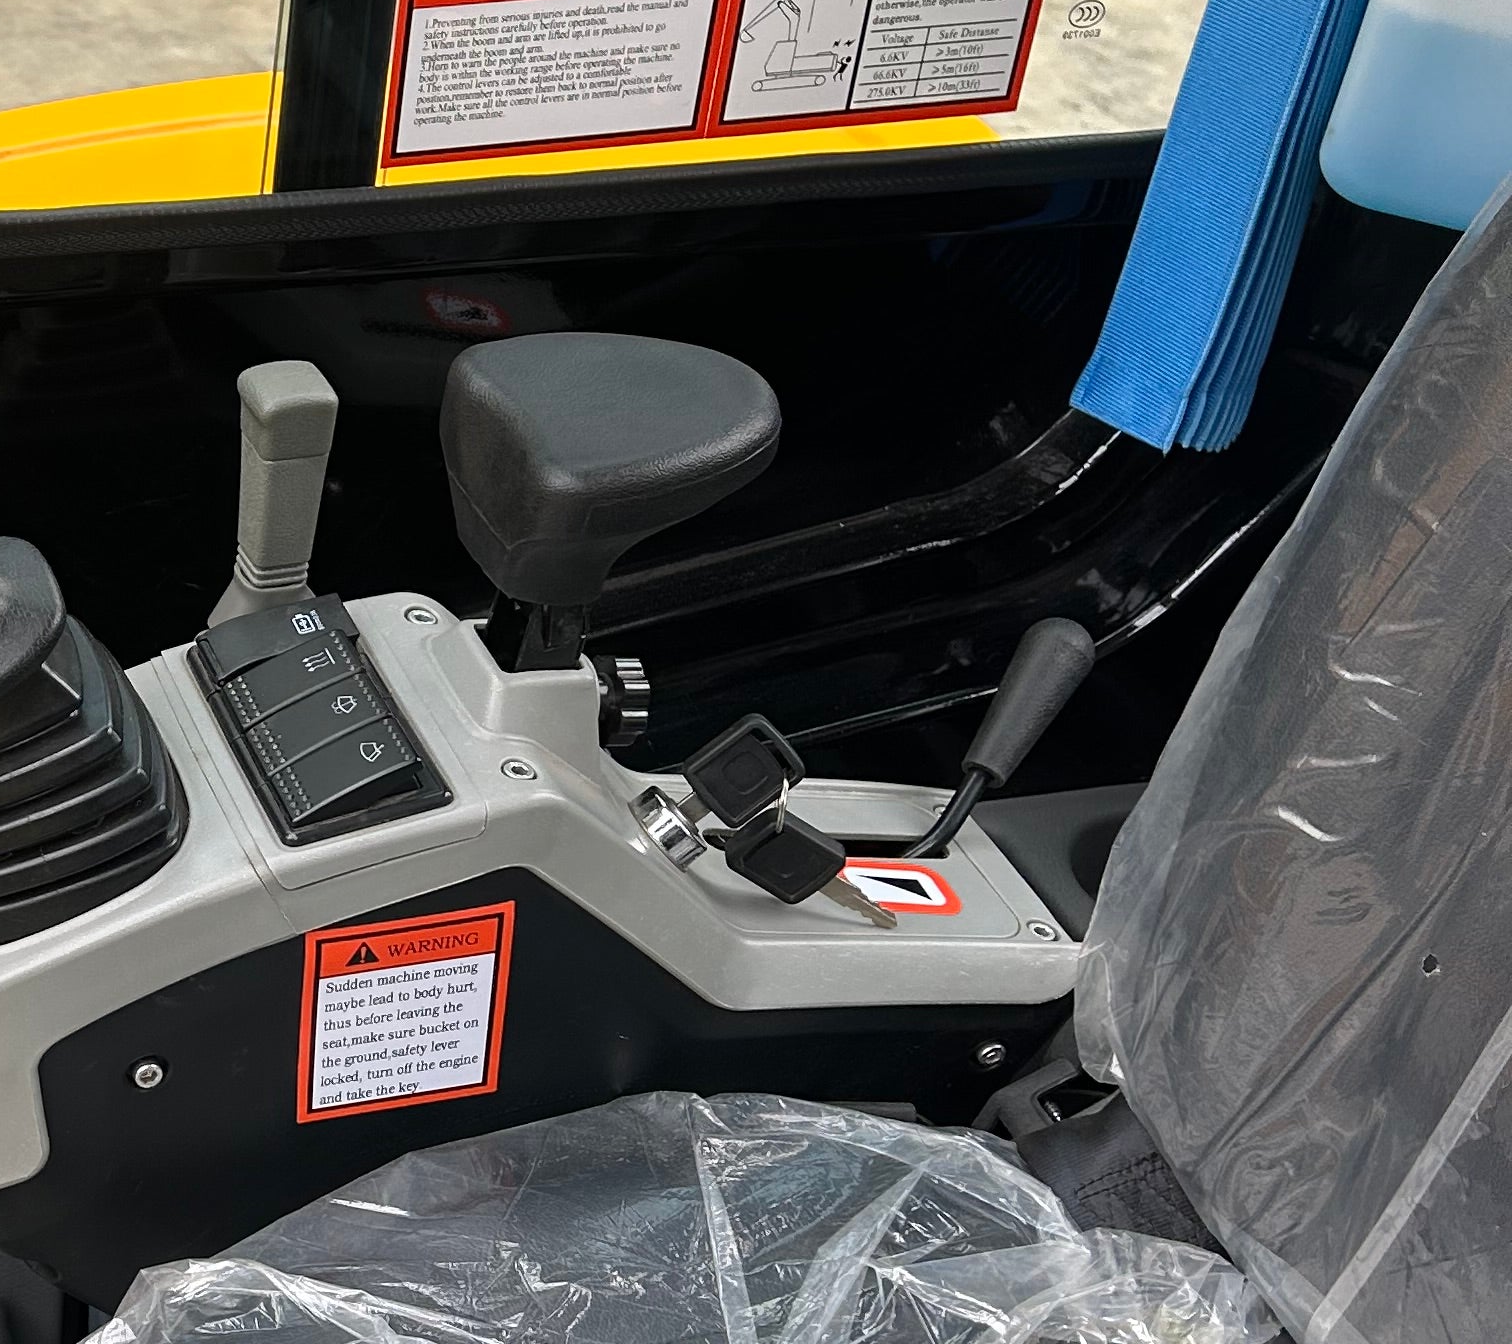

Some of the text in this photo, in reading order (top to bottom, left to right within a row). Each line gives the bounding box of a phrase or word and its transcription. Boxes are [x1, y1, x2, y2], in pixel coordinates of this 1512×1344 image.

[479, 14, 499, 24] from
[501, 14, 529, 22] serious
[533, 11, 563, 21] injuries
[565, 7, 581, 17] and
[627, 2, 639, 11] the
[642, 0, 672, 10] manual
[424, 29, 448, 42] safety
[451, 26, 499, 37] instructions
[502, 22, 537, 35] carefully
[540, 19, 566, 30] before
[457, 38, 470, 48] the
[472, 37, 495, 46] boom
[497, 34, 513, 44] and
[514, 35, 531, 43] arm
[533, 33, 546, 41] are
[548, 29, 570, 40] lifted
[592, 26, 600, 36] is
[601, 22, 643, 37] prohibited
[655, 23, 666, 33] go
[882, 33, 914, 45] Voltage
[939, 29, 958, 40] Safe
[421, 50, 466, 63] underneath
[468, 49, 481, 59] the
[484, 48, 507, 57] boom
[509, 45, 524, 55] and
[462, 60, 482, 68] warn
[484, 57, 496, 67] the
[498, 54, 526, 67] people
[528, 51, 557, 63] around
[559, 51, 572, 60] the
[574, 48, 608, 59] machine
[610, 45, 625, 56] and
[627, 44, 649, 54] make
[651, 44, 668, 52] sure
[419, 73, 440, 84] body
[441, 72, 449, 81] is
[452, 70, 477, 79] within
[479, 68, 492, 77] the
[495, 66, 527, 76] working
[530, 65, 553, 74] range
[555, 61, 581, 71] before
[583, 59, 621, 70] operating
[623, 56, 636, 65] the
[443, 80, 473, 91] control
[475, 79, 499, 88] levers
[501, 78, 516, 86] can
[518, 75, 528, 85] be
[530, 72, 564, 85] adjusted
[583, 66, 631, 79] comfortable
[505, 87, 533, 96] restore
[535, 84, 555, 93] them
[558, 81, 576, 91] back
[589, 77, 618, 88] normal
[619, 76, 652, 87] position
[653, 73, 672, 83] after
[463, 102, 480, 111] sure
[482, 99, 493, 109] all
[495, 98, 507, 107] the
[509, 95, 539, 106] control
[541, 94, 565, 103] levers
[567, 93, 579, 101] are
[582, 92, 590, 100] in
[591, 87, 620, 99] normal
[621, 85, 654, 98] position
[657, 83, 682, 93] before
[413, 115, 451, 127] operating
[454, 112, 466, 121] the
[387, 932, 479, 958] WARNING
[326, 963, 478, 993] Sudden machine moving
[325, 982, 477, 1012] maybe lead to body hurt,
[324, 1002, 463, 1031] thus before leaving the
[388, 1028, 415, 1040] sure
[419, 1020, 460, 1035] bucket
[463, 1019, 478, 1029] on
[322, 1056, 341, 1068] the
[431, 1040, 460, 1052] lever
[321, 1055, 478, 1086] locked, turn off the engine
[319, 1091, 342, 1105] and
[346, 1088, 372, 1100] take
[376, 1085, 395, 1096] the
